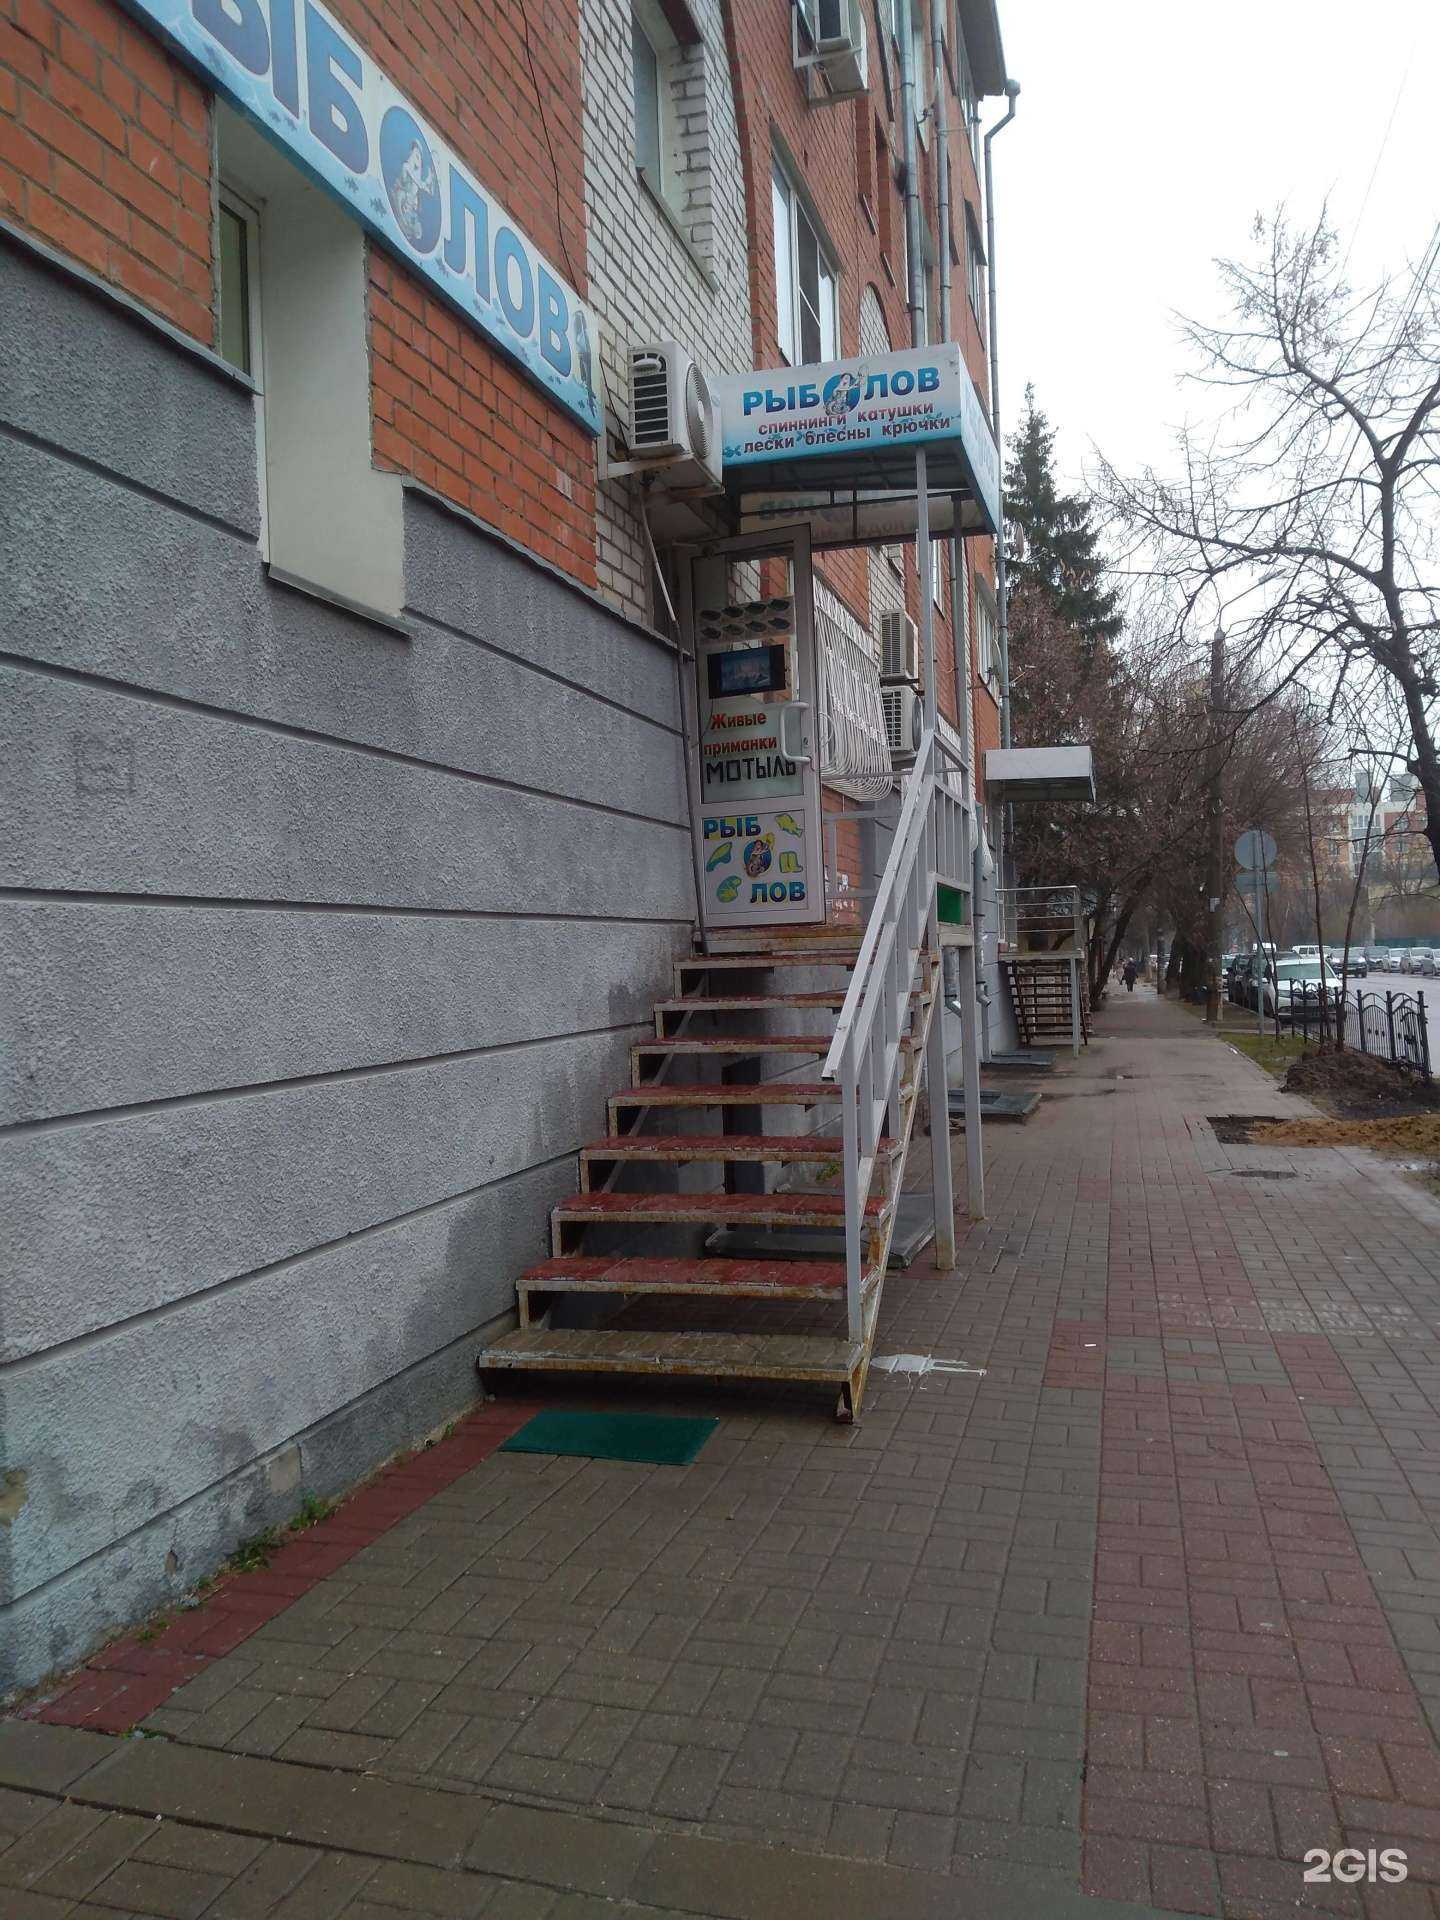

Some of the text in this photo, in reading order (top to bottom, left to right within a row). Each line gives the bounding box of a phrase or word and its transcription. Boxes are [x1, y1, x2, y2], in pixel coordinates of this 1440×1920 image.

[743, 367, 940, 417] РЫБОЛОВ
[758, 403, 934, 436] спиннинги катушки
[744, 418, 950, 454] лески блесны крючки
[711, 712, 767, 730] Живые
[704, 737, 777, 757] приманки
[706, 756, 797, 784] МОТЫЛЬ
[703, 816, 762, 840] РЫБ
[750, 881, 806, 904] ЛОВ
